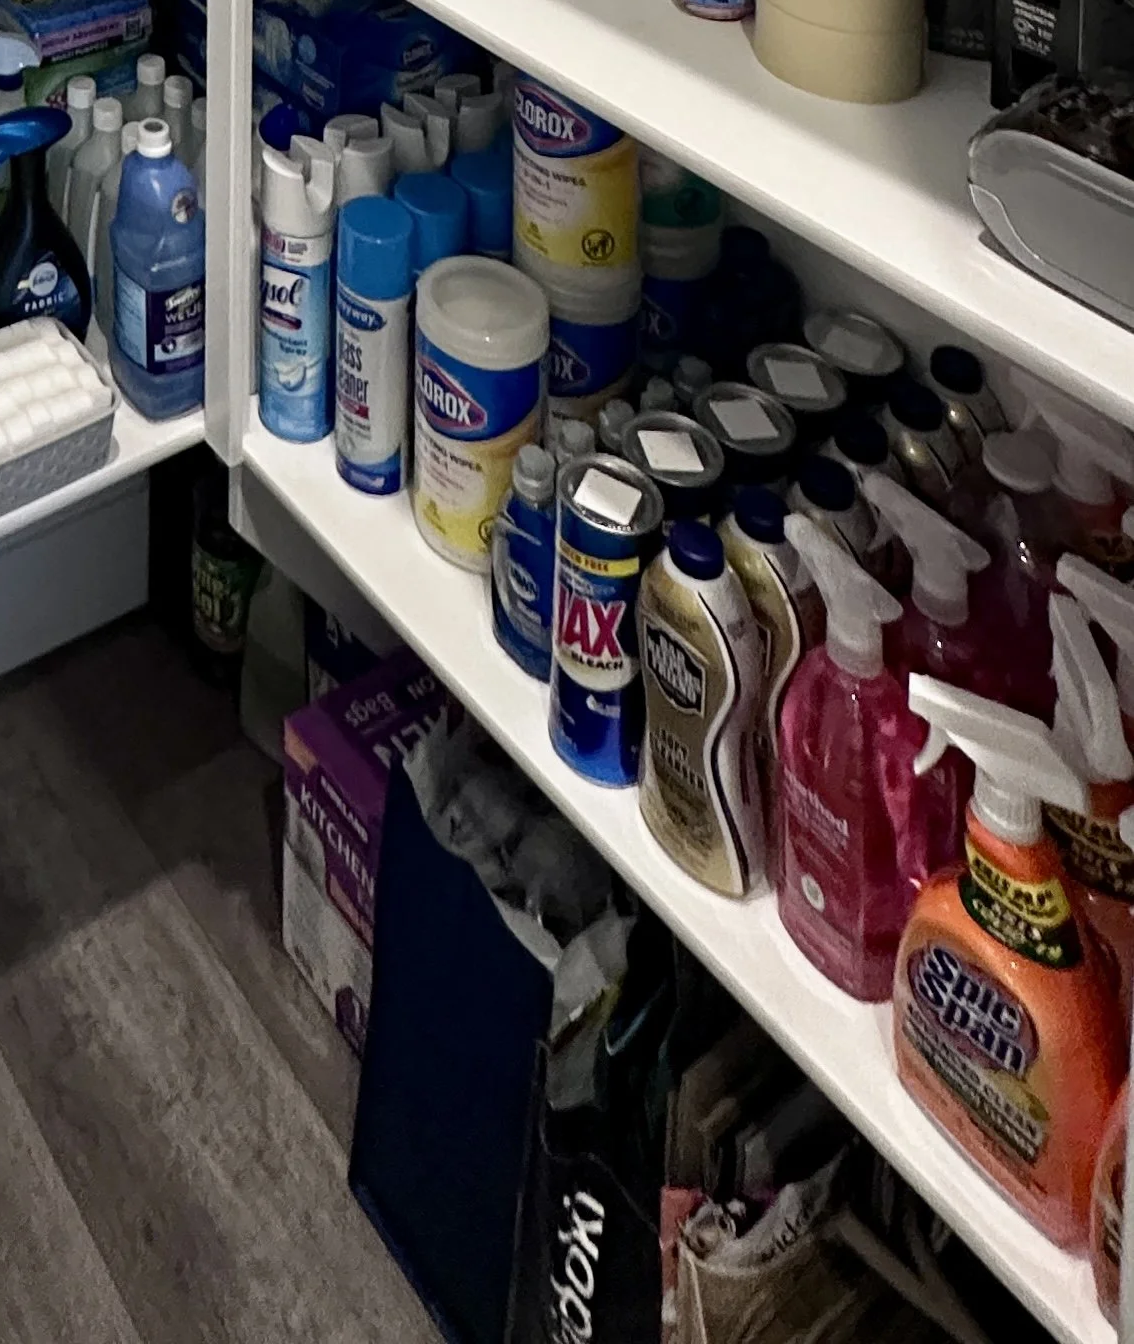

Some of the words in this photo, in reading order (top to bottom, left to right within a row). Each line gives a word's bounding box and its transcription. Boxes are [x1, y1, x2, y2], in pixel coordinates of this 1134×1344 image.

[569, 651, 625, 670] BLEACH
[299, 781, 375, 900] KITCHEN
[925, 946, 1021, 1031] Spic
